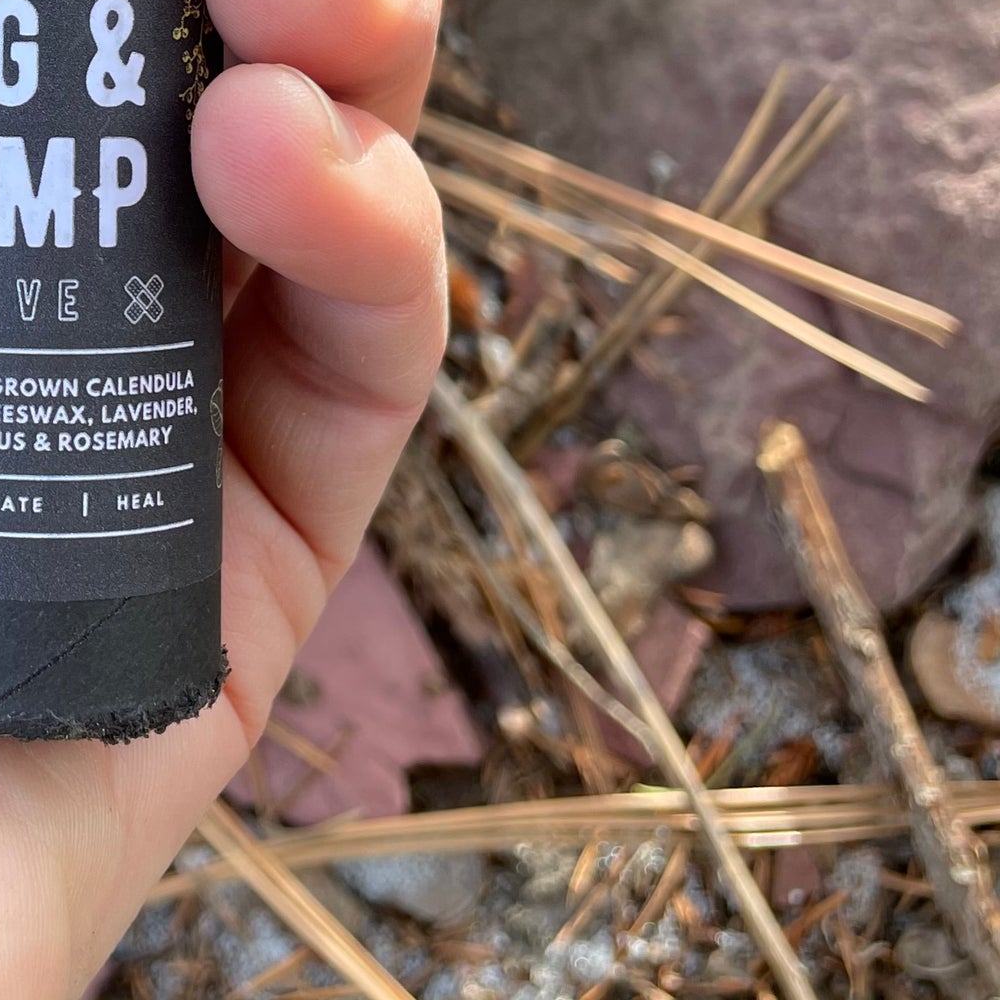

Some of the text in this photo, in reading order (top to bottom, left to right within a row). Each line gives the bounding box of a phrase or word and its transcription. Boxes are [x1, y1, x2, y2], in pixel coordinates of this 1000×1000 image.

[86, 370, 194, 397] CALENDULA
[102, 396, 197, 423] LAVENDER,
[34, 432, 51, 451] &
[59, 425, 172, 451] ROSEMARY
[117, 491, 164, 510] HEAL
